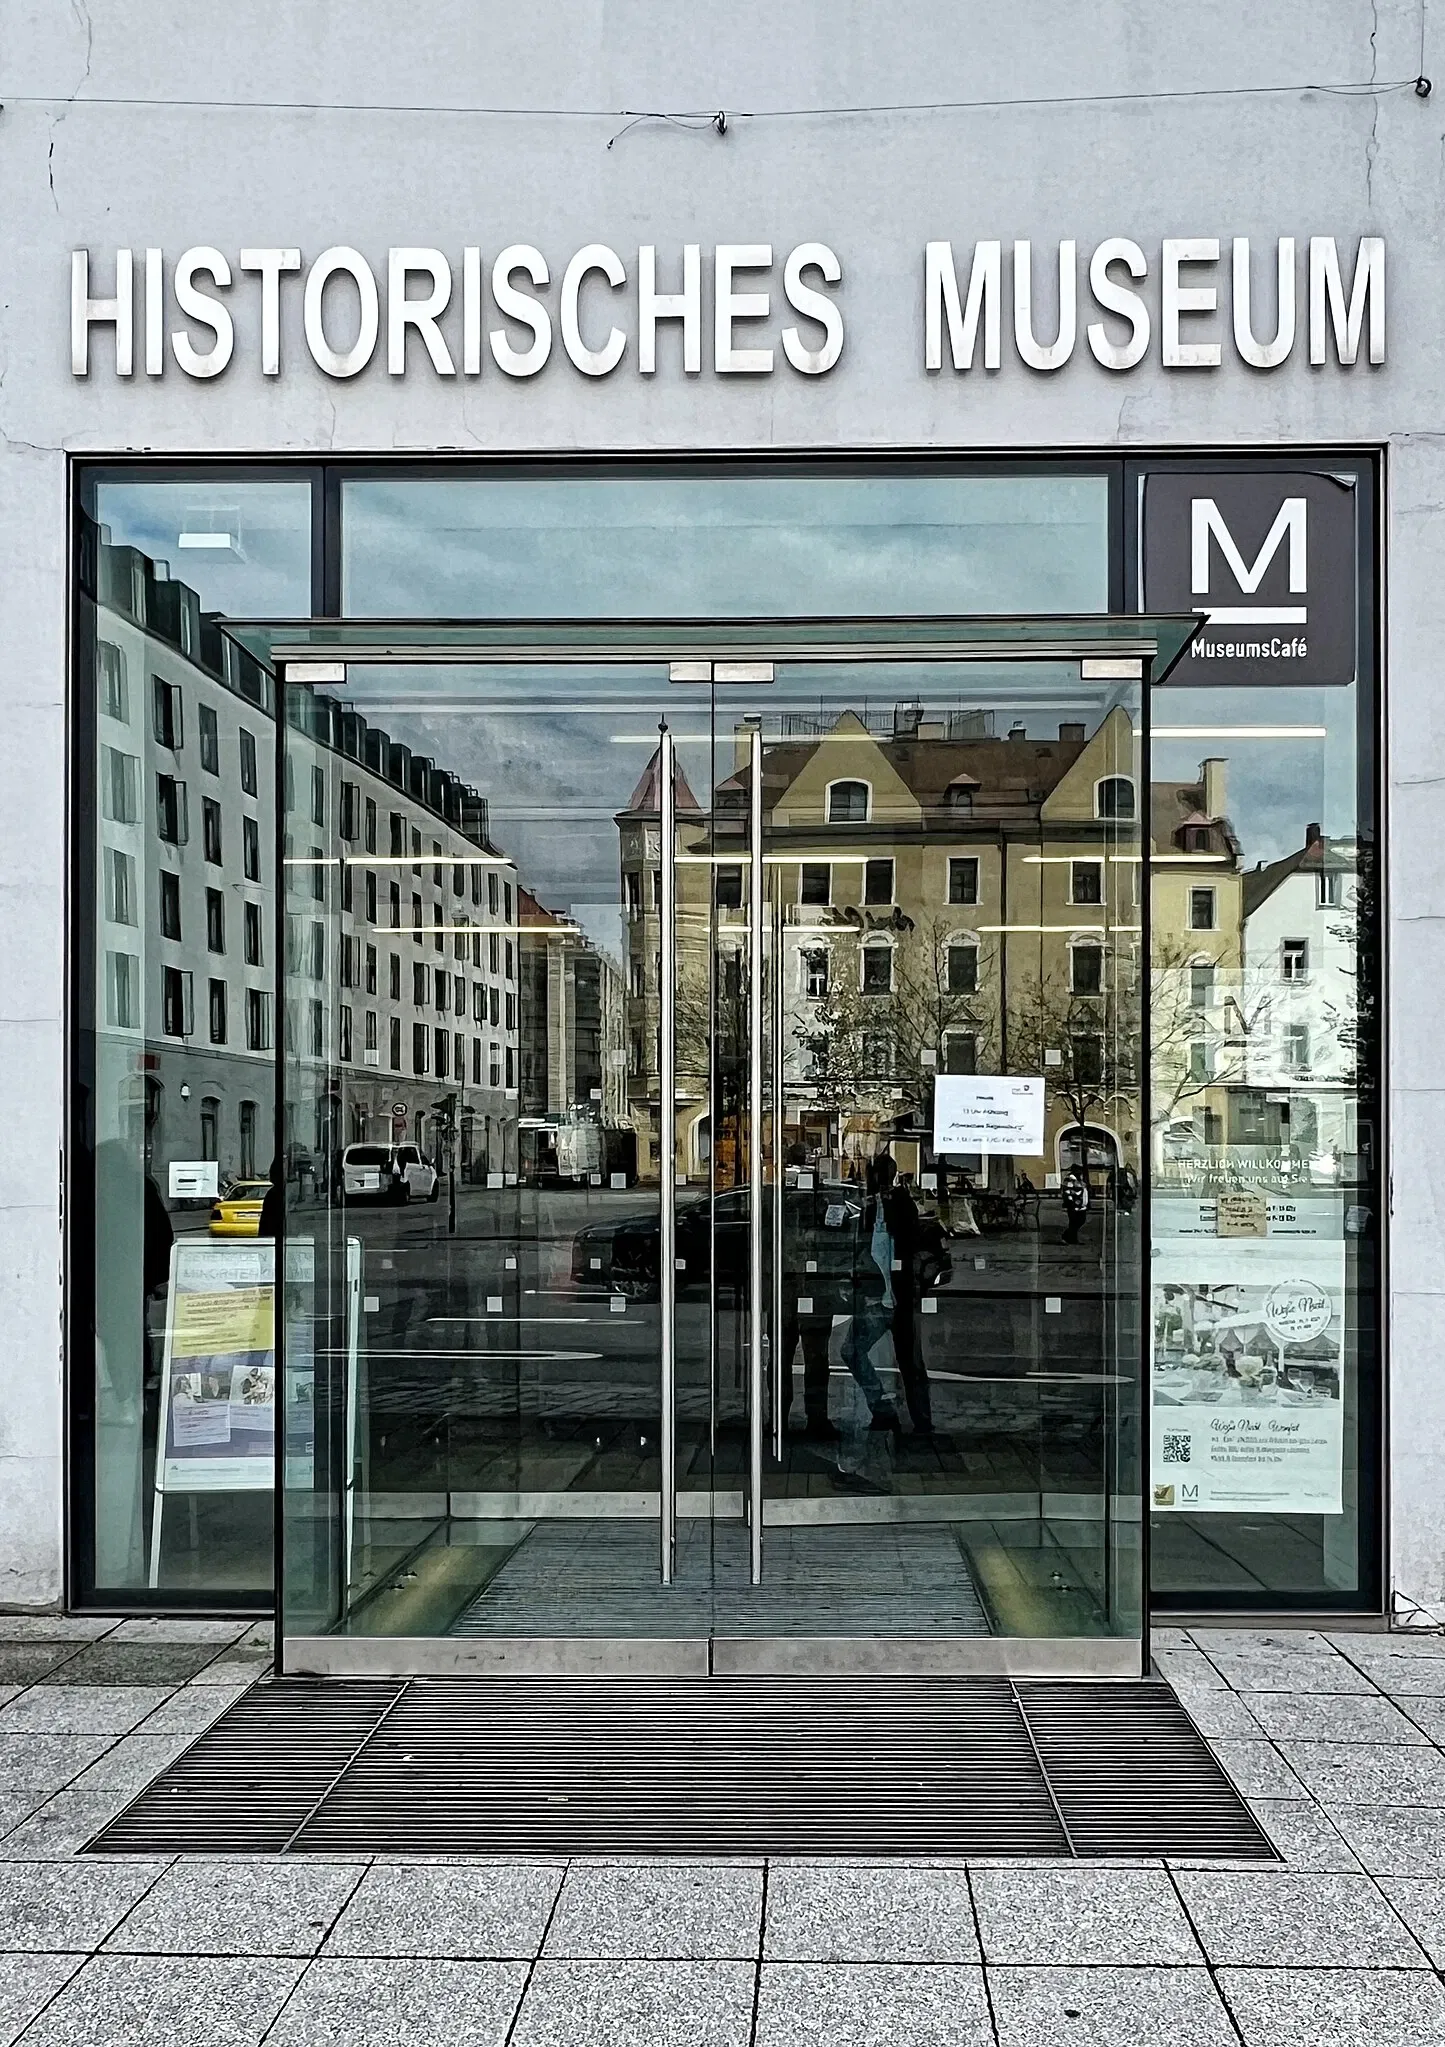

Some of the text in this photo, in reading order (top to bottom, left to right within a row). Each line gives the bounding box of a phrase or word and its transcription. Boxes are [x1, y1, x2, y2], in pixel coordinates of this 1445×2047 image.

[70, 235, 1386, 379] HISTORISCHES MUSEUM
[1191, 497, 1307, 594] M
[1191, 637, 1307, 658] MuseumsCafé
[1178, 1158, 1316, 1170] HERZLICH WILLKOME
